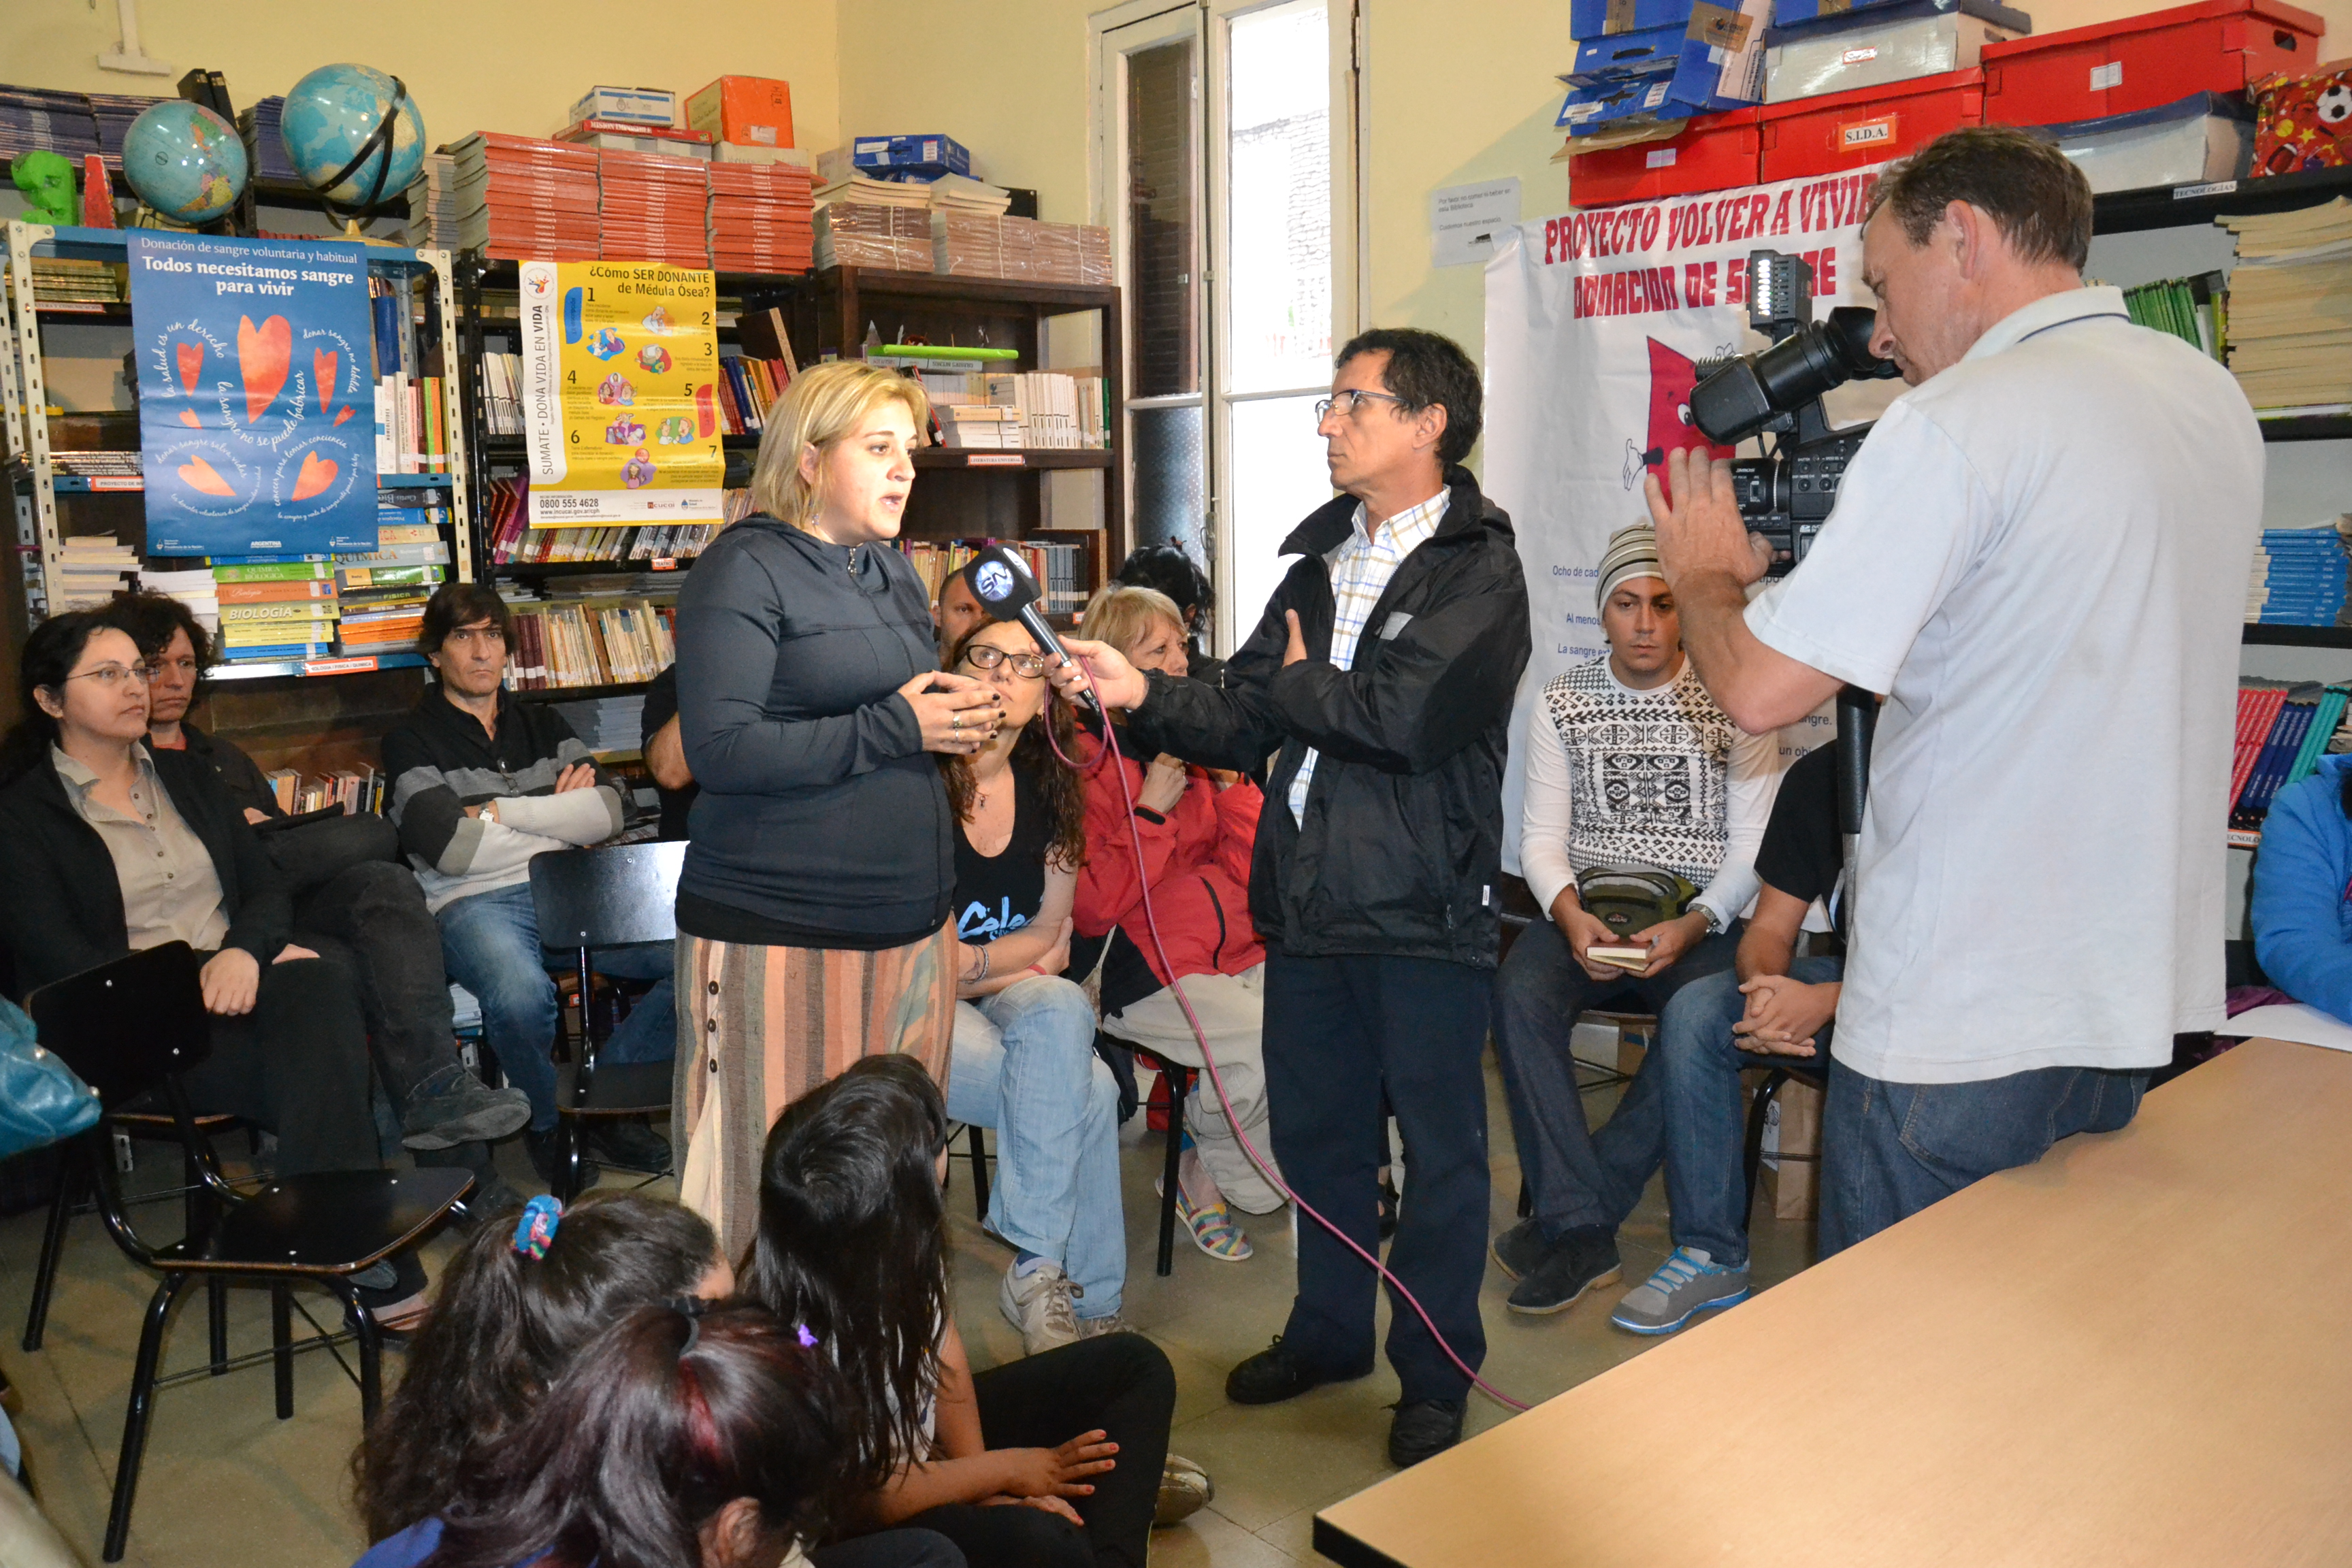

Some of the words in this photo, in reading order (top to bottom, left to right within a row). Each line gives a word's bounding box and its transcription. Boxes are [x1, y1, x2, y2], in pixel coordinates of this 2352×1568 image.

[1845, 127, 1887, 143] S.I.D.A.
[1544, 206, 1662, 265] PROYECTO
[1666, 190, 1767, 252] VOLVER
[1770, 189, 1791, 235] A
[141, 238, 195, 251] Donación
[198, 242, 211, 252] de
[214, 246, 250, 259] sangre
[252, 247, 306, 260] voluntaria
[308, 254, 314, 263] y
[316, 251, 357, 264] habitual
[142, 256, 193, 273] Todos
[197, 261, 297, 280] necesitamos
[301, 270, 354, 287] sangre
[589, 265, 630, 280] ¿Cómo
[633, 268, 655, 281] SER
[657, 270, 709, 284] DONANTE
[216, 280, 254, 296] para
[258, 281, 294, 296] vivir
[617, 283, 632, 295] de
[636, 283, 675, 297] Médula
[678, 284, 710, 298] Ósea?
[1684, 262, 1718, 308] DE
[587, 287, 595, 302] 1
[167, 321, 185, 332] un
[532, 305, 542, 333] VIDA
[702, 311, 710, 326] 2
[158, 333, 169, 347] es
[187, 318, 229, 359] derecho
[303, 328, 327, 340] donar
[327, 329, 352, 354] sangre
[535, 336, 546, 352] EN
[704, 342, 713, 356] 3
[152, 347, 174, 383] salud
[536, 354, 546, 382] VIDA
[567, 370, 577, 385] 4
[217, 381, 234, 395] la
[289, 370, 305, 421] fabricar
[684, 383, 693, 397] 5
[536, 383, 548, 419] DONA
[217, 396, 242, 437] sangre
[240, 432, 255, 445] no
[257, 437, 271, 447] se
[272, 419, 299, 453] puede
[308, 434, 348, 449] conciencia
[570, 429, 580, 444] 6
[284, 440, 308, 459] tomar
[538, 429, 553, 475] SUMATE
[708, 445, 717, 458] 7
[157, 446, 178, 465] donar
[178, 438, 210, 449] sangre
[210, 440, 232, 459] salva
[231, 456, 248, 478] vidas
[275, 457, 288, 479] para
[272, 477, 281, 507] conocer
[540, 499, 559, 508] 0800
[562, 499, 577, 508] 555
[579, 498, 599, 508] 4628
[378, 530, 396, 540] ICA
[1552, 565, 1571, 576] Ocho
[1573, 566, 1583, 576] de
[1584, 567, 1599, 578] cad
[383, 591, 411, 600] FISICA
[229, 604, 293, 621] BIOLOGÍA
[1567, 612, 1574, 623] Al
[1575, 615, 1601, 625] menos
[1558, 643, 1567, 654] La
[1569, 645, 1597, 658] sangre
[1778, 747, 1792, 755] un
[2227, 834, 2260, 843] ECNOLO
